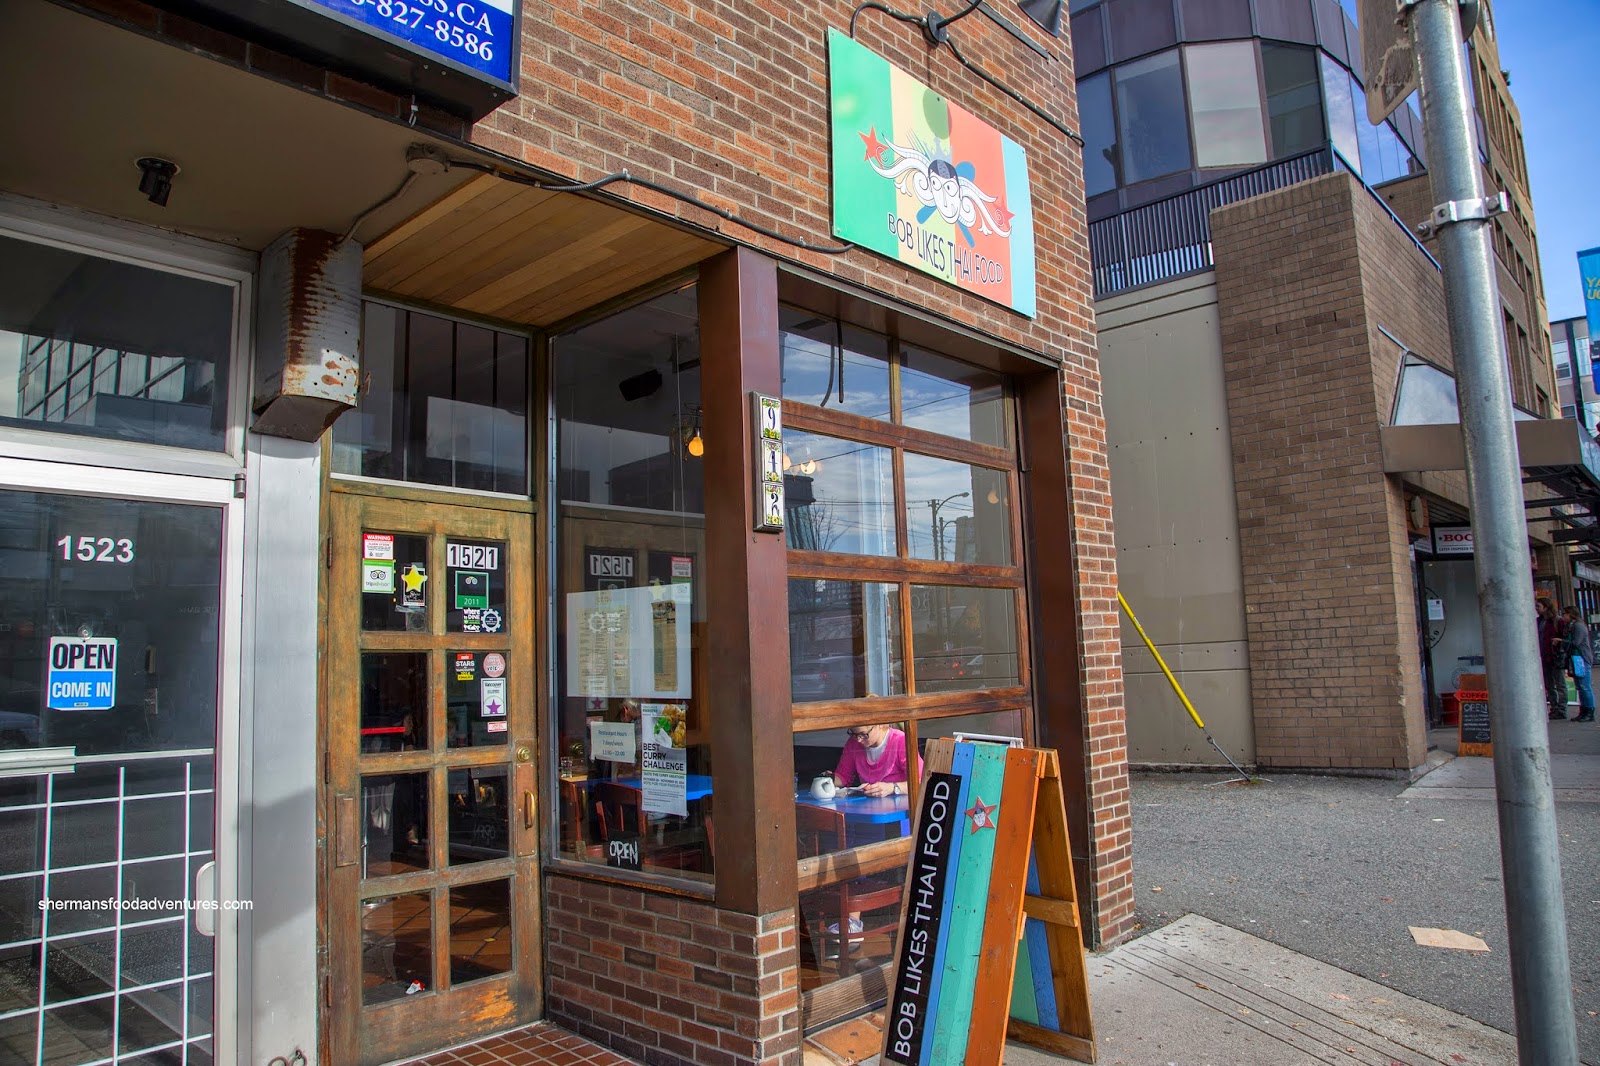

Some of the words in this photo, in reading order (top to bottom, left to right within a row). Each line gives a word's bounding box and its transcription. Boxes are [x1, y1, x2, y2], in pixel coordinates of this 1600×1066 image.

[350, 0, 493, 61] -827-8586
[888, 213, 914, 251] BOB
[916, 226, 946, 272] LIKES
[947, 240, 973, 282] THAI
[974, 253, 1004, 284] FOOD
[57, 535, 134, 563] 1523
[449, 544, 496, 569] 1521
[463, 597, 479, 606] 2011
[52, 643, 114, 669] OPEN
[52, 682, 92, 698] COME
[96, 682, 111, 697] IN
[1463, 703, 1488, 712] OPEN
[643, 743, 660, 751] BEST
[643, 752, 667, 760] CURRY
[643, 760, 684, 771] CHALLENGE
[924, 781, 950, 858] FOOD
[609, 840, 639, 866] OPEN
[914, 864, 937, 921] THAI
[903, 927, 928, 995] LIKES
[894, 1001, 917, 1057] BOB
